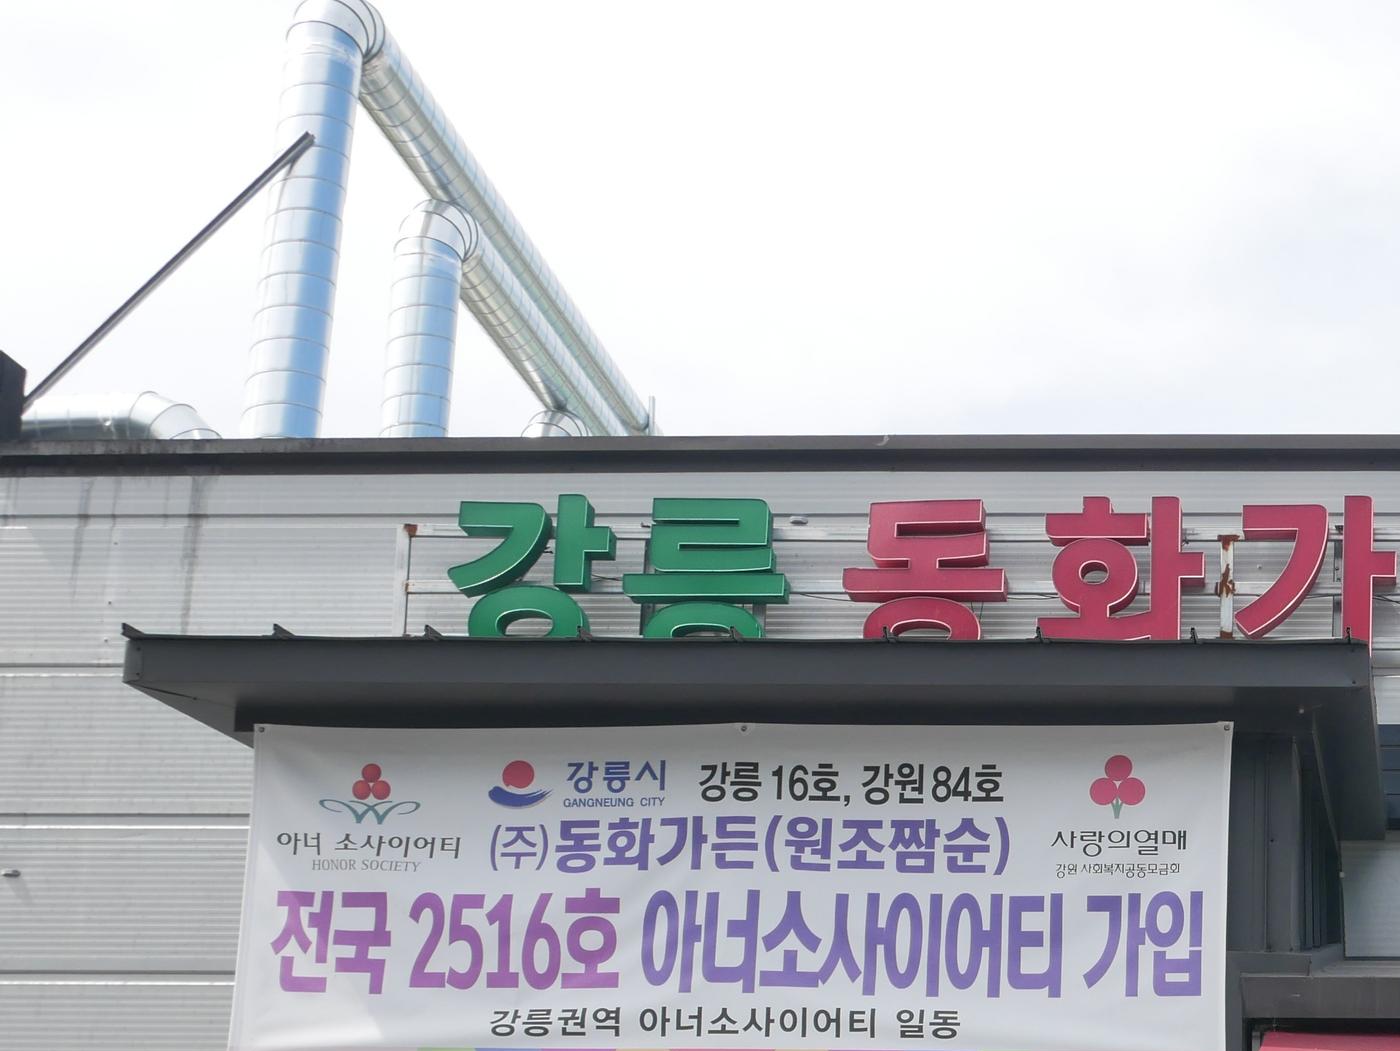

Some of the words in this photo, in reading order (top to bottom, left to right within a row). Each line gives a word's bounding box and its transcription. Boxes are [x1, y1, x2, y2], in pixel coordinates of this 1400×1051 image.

[448, 494, 790, 638] 강릉
[566, 759, 667, 793] 강릉시
[563, 797, 634, 808] GANGNEUNG
[640, 796, 665, 808] CITY
[277, 832, 322, 858] 아너
[334, 832, 462, 860] 소사이어티
[489, 814, 1011, 874] (주)동화가든(원조짬순)
[1050, 829, 1188, 858] 사랑의열매
[312, 859, 357, 872] HONOR
[361, 859, 421, 873] SOCIETY
[1056, 863, 1078, 879] 강원
[1081, 863, 1180, 879] 사회복지공동모금회
[271, 890, 392, 994] 전국
[408, 888, 622, 991] 2516호
[640, 889, 1064, 998] 아너소사이어티
[1082, 890, 1204, 998] 가입
[488, 1006, 622, 1038] 강릉권역
[638, 1006, 877, 1038] 아너소사이어티
[896, 1008, 962, 1040] 일동
